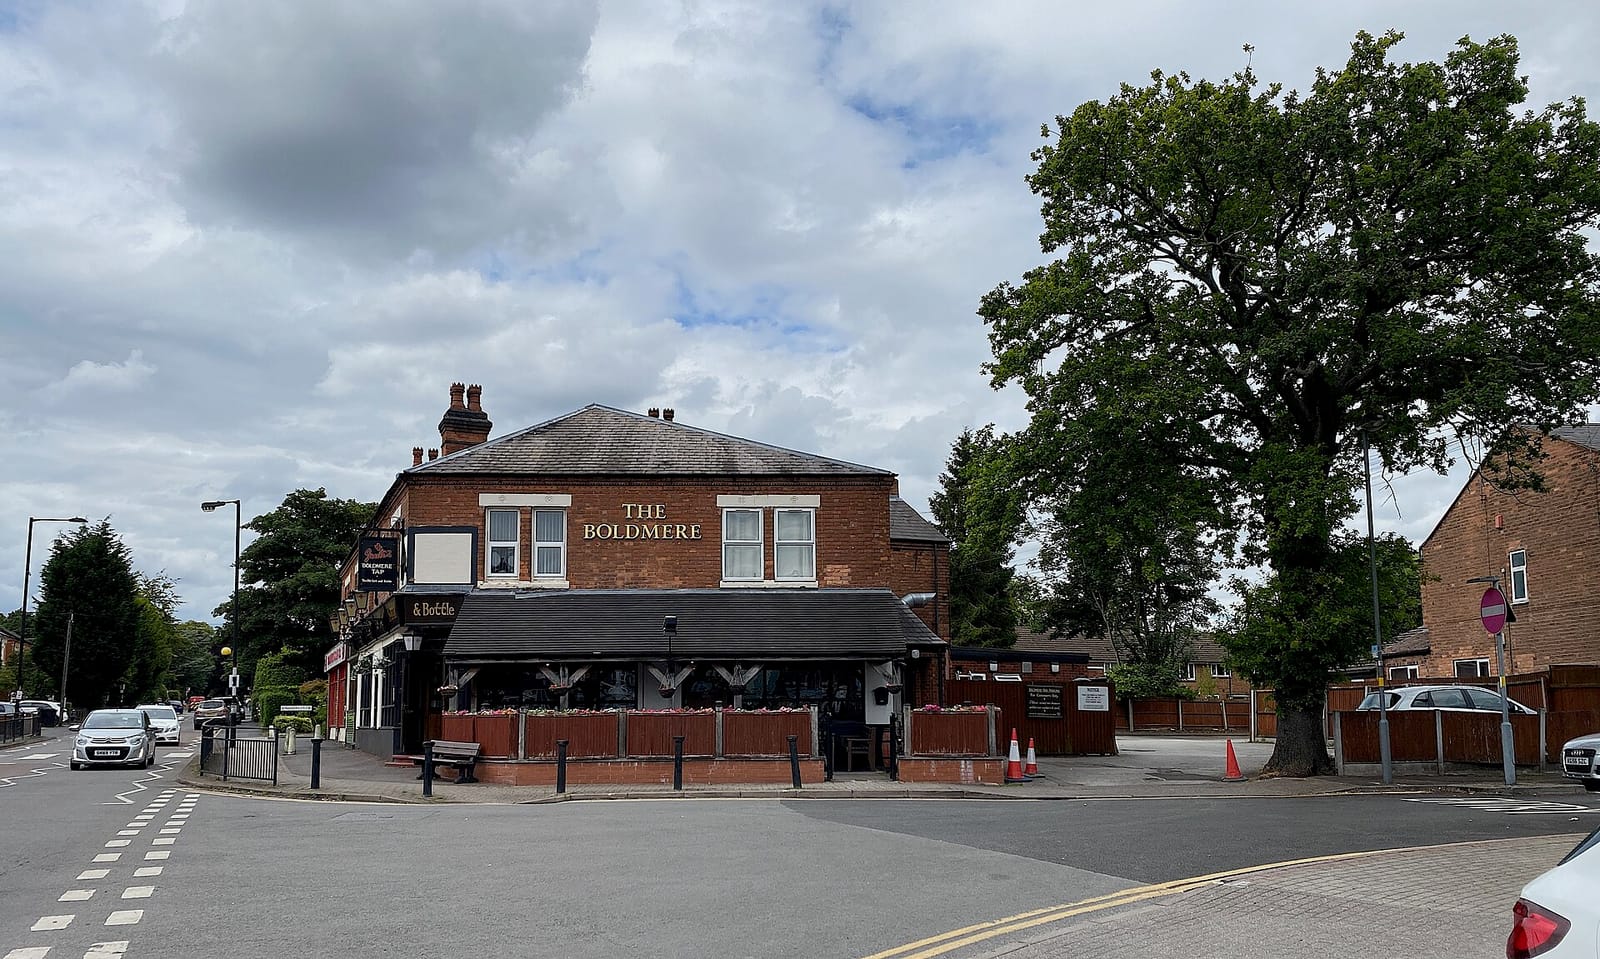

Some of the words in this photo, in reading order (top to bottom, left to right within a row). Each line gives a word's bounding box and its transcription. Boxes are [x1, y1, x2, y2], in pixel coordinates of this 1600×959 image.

[621, 503, 667, 519] THE
[583, 523, 702, 540] BOLDMERE
[413, 602, 422, 616] &
[422, 602, 455, 616] Bottle
